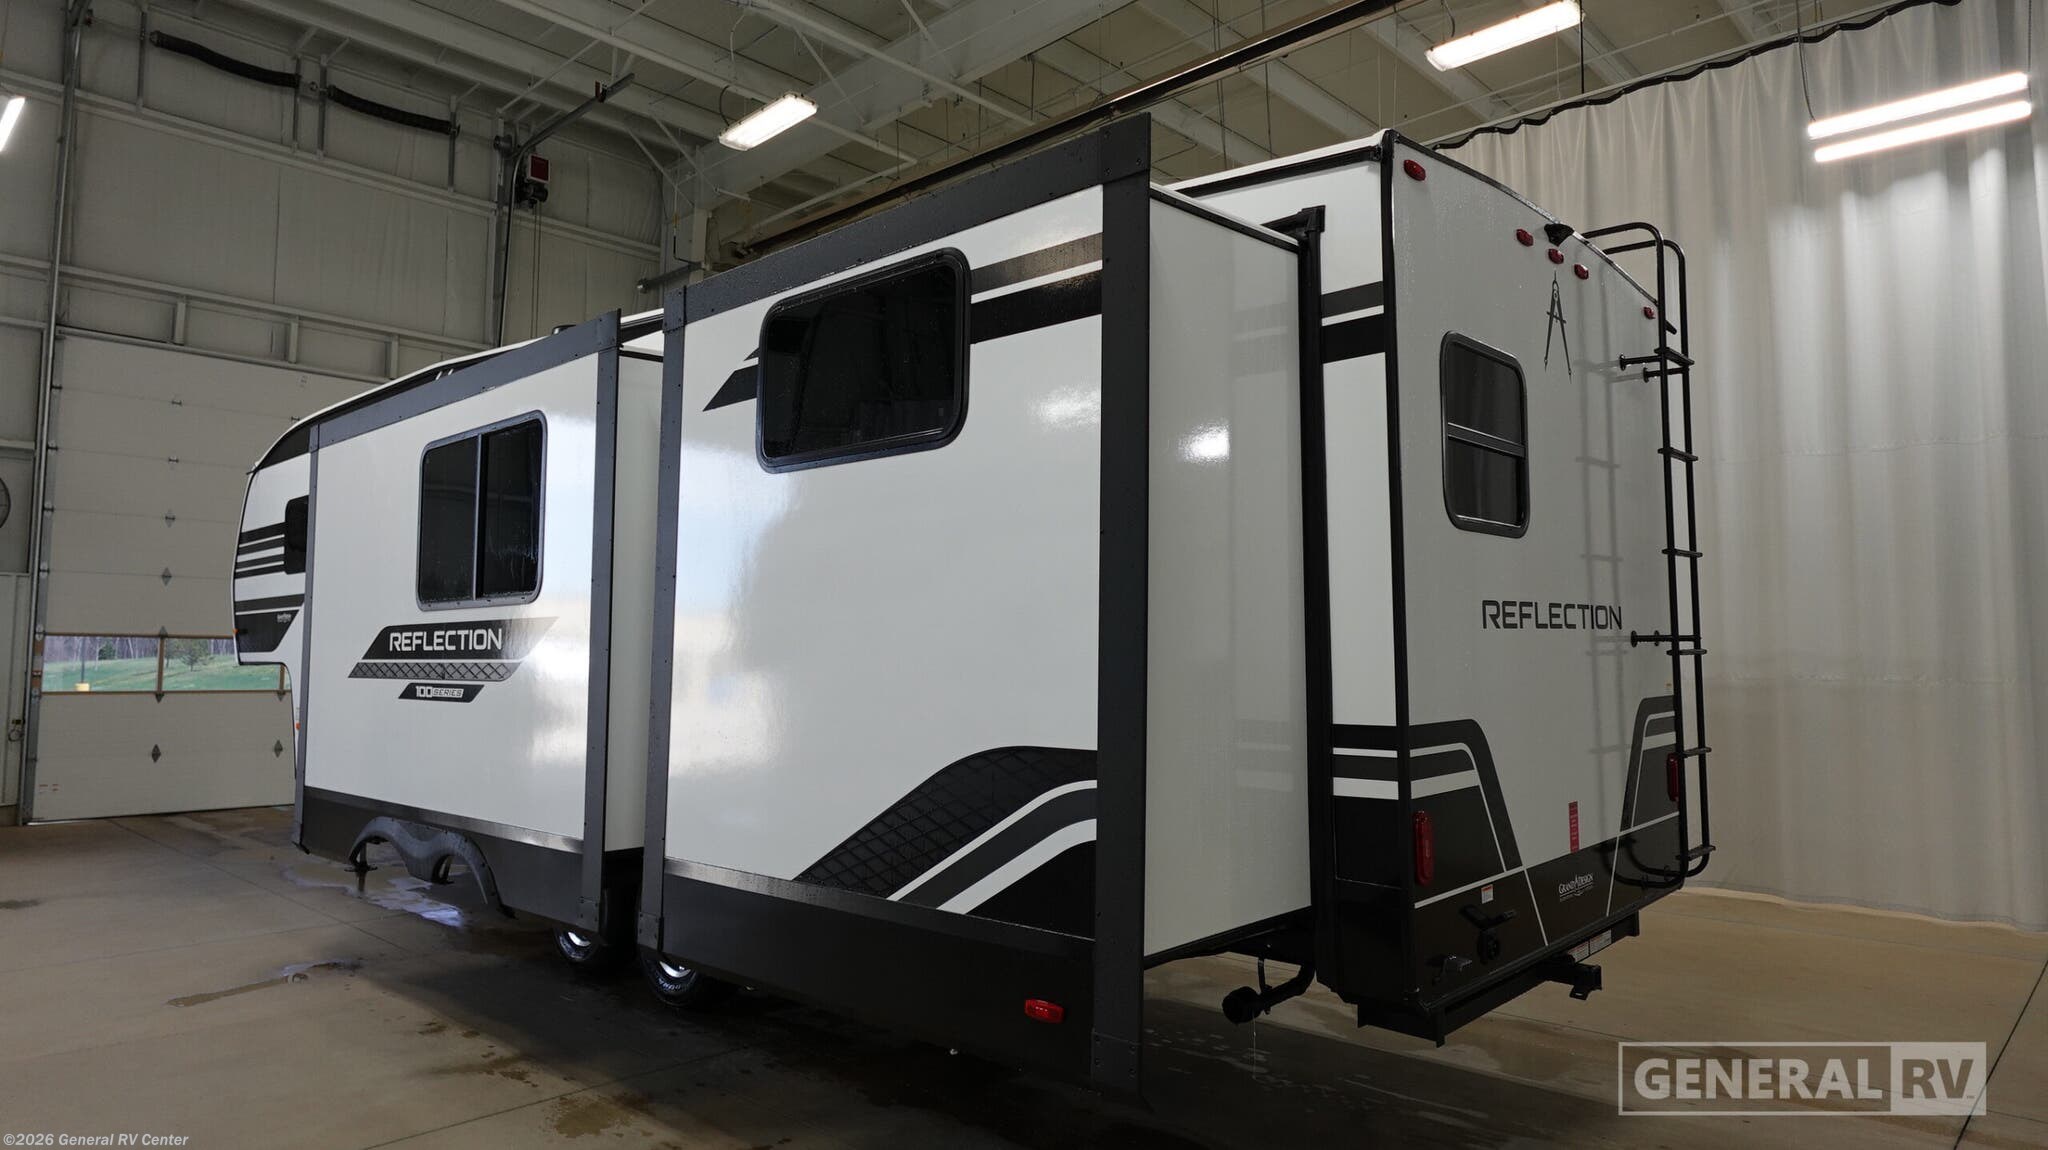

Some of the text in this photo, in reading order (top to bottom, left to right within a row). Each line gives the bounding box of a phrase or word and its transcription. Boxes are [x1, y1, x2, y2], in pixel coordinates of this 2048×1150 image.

[1482, 600, 1623, 630] REFLECTION
[389, 628, 503, 652] REFLECTION
[415, 685, 463, 698] 100 SERIES
